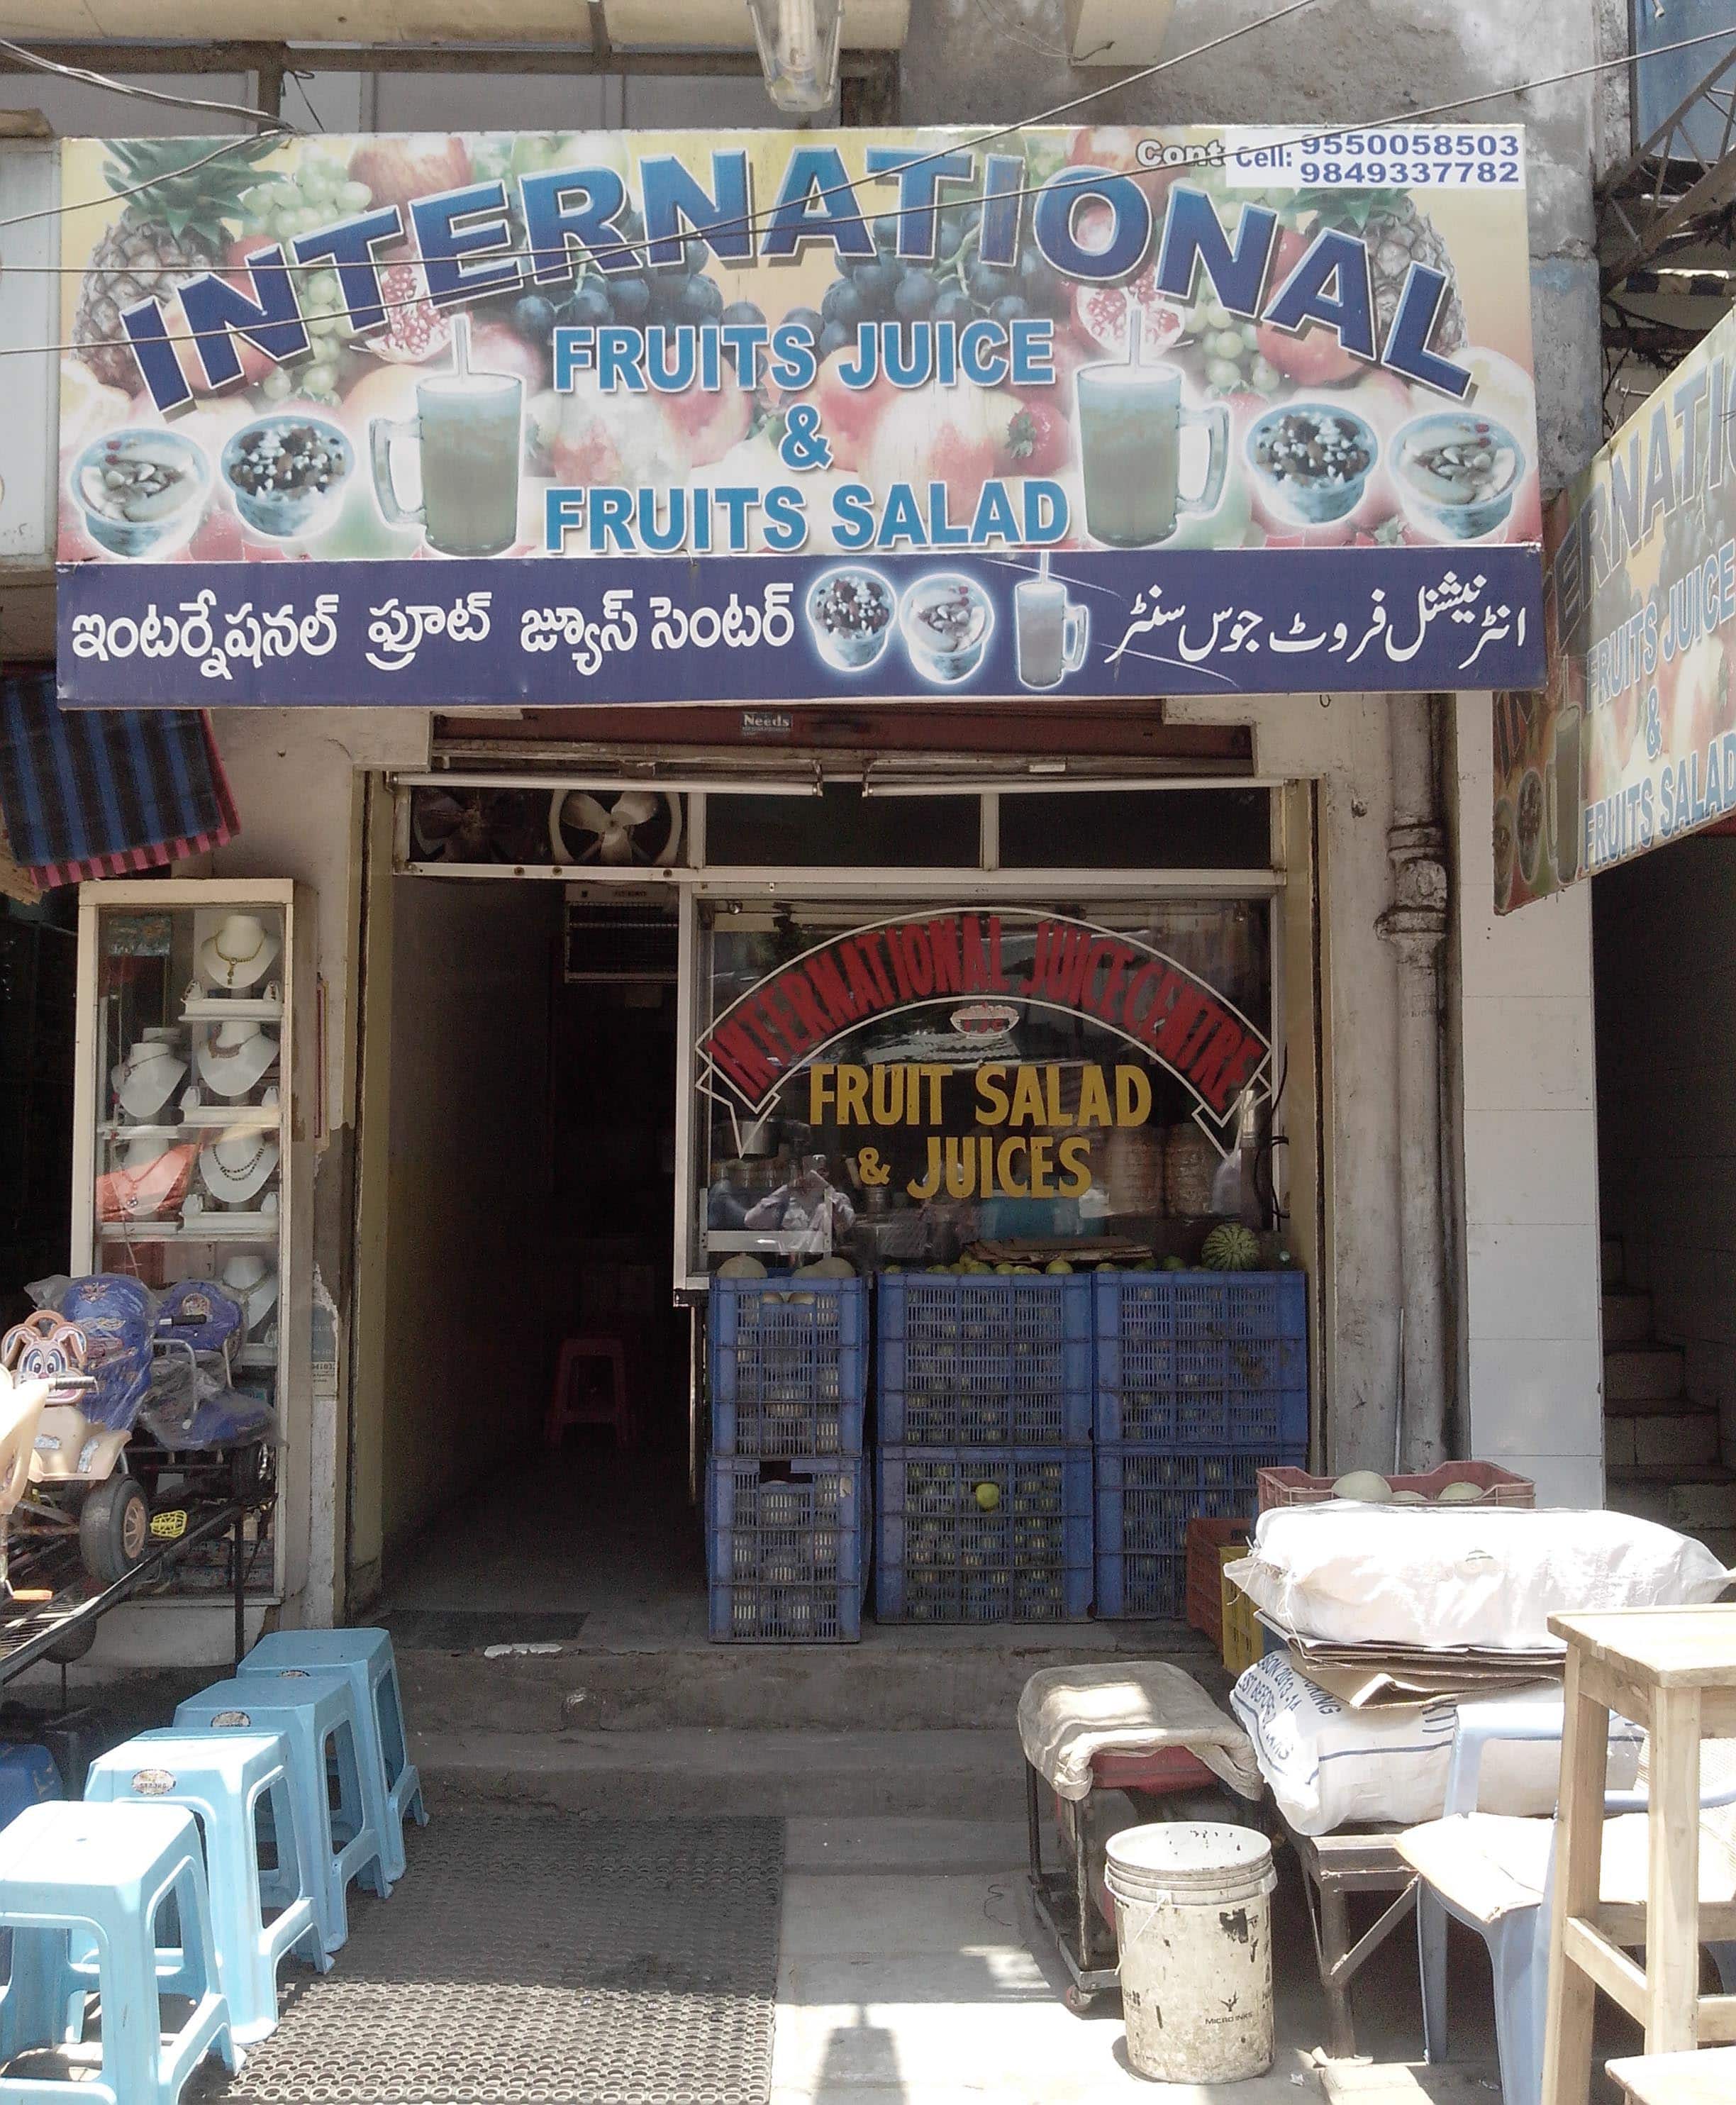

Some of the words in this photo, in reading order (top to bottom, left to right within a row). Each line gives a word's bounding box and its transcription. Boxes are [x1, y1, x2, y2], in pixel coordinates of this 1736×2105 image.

[1236, 144, 1292, 169] Cell:
[1301, 134, 1519, 156] 9550058503
[1301, 161, 1519, 184] 9849337782
[120, 146, 1474, 413] INTERNATIONAL
[552, 323, 817, 393] FRUITS
[839, 319, 1056, 389] JUICE
[779, 404, 833, 472] &
[544, 484, 808, 555] FRUITS
[831, 481, 1069, 549] SALAD
[1586, 601, 1658, 714] FRUITS
[1663, 538, 1736, 663] JUICE
[744, 713, 789, 727] Needs
[1645, 685, 1662, 760] &
[1584, 776, 1657, 873] FRUITS
[1659, 730, 1736, 840] SALAD
[810, 1064, 953, 1126] FRUIT
[975, 1063, 1152, 1127] SALAD
[859, 1146, 891, 1186] &
[907, 1137, 1093, 1200] JUICES
